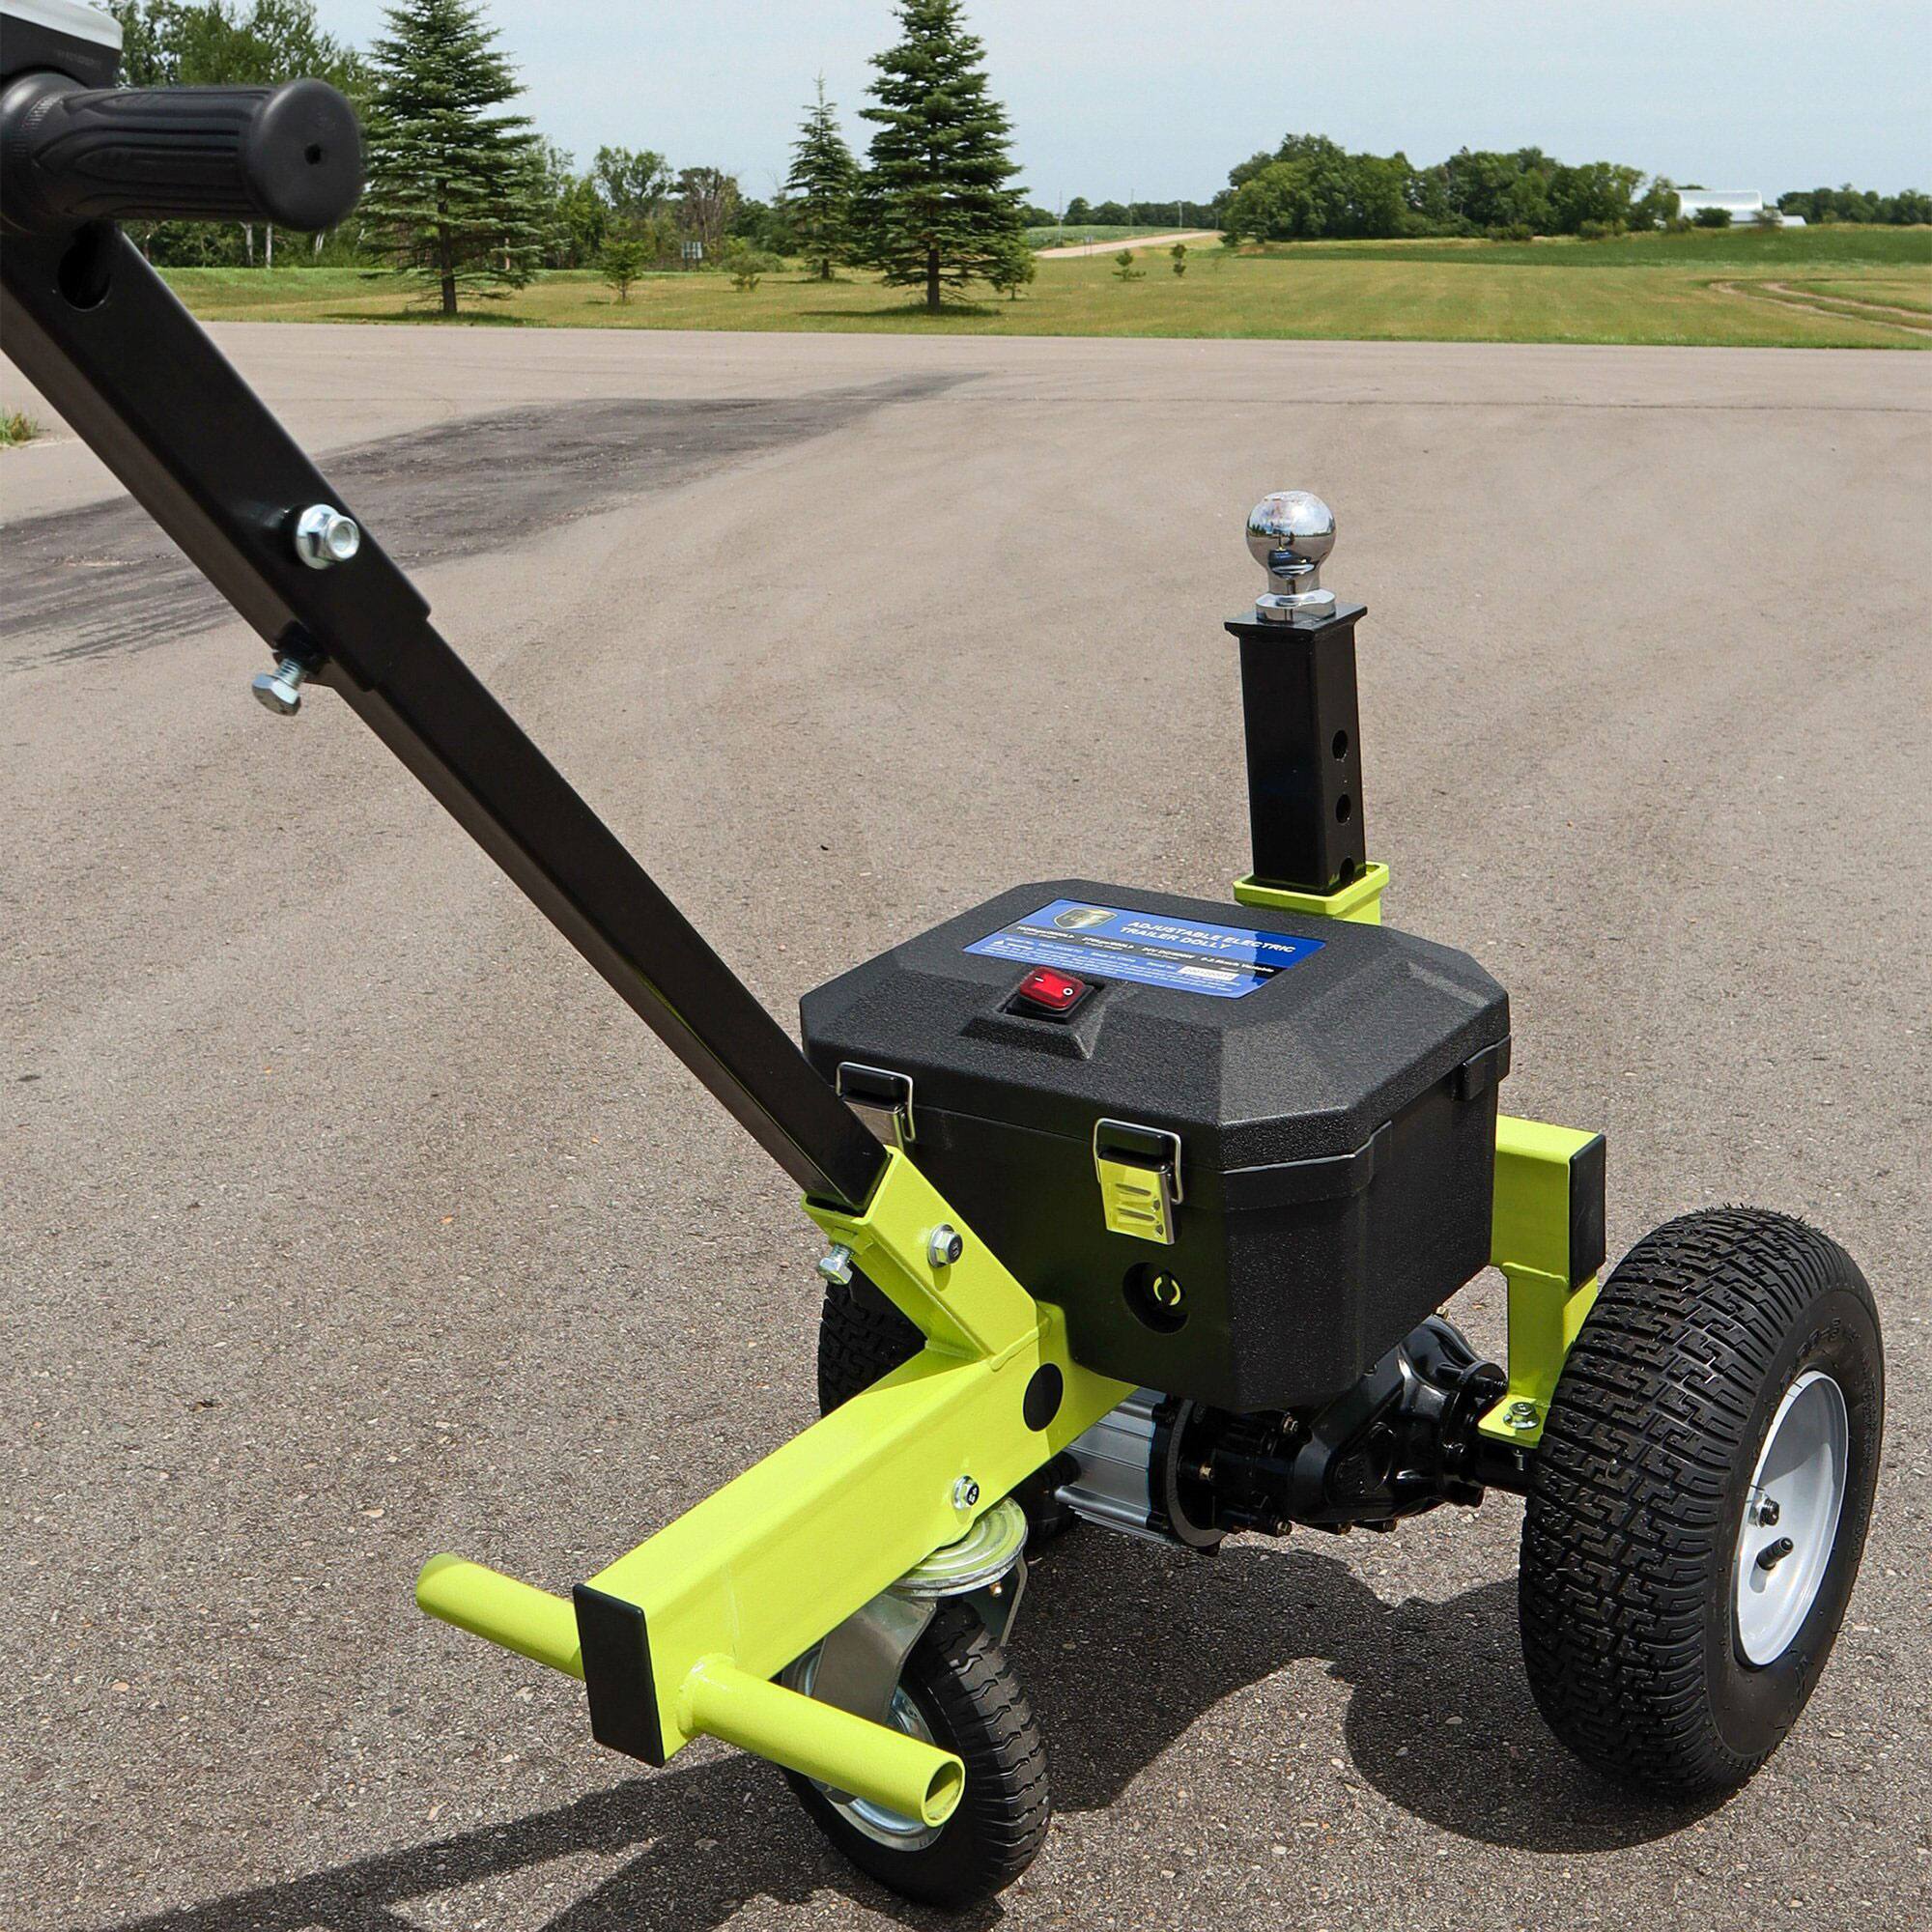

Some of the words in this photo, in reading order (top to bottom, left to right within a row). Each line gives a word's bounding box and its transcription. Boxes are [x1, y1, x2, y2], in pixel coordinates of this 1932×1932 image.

[1120, 926, 1179, 942] TRAILER
[1179, 937, 1232, 951] DOLLY
[1127, 921, 1222, 943] ADJUSTABLE
[1221, 936, 1296, 953] ELECTRIC
